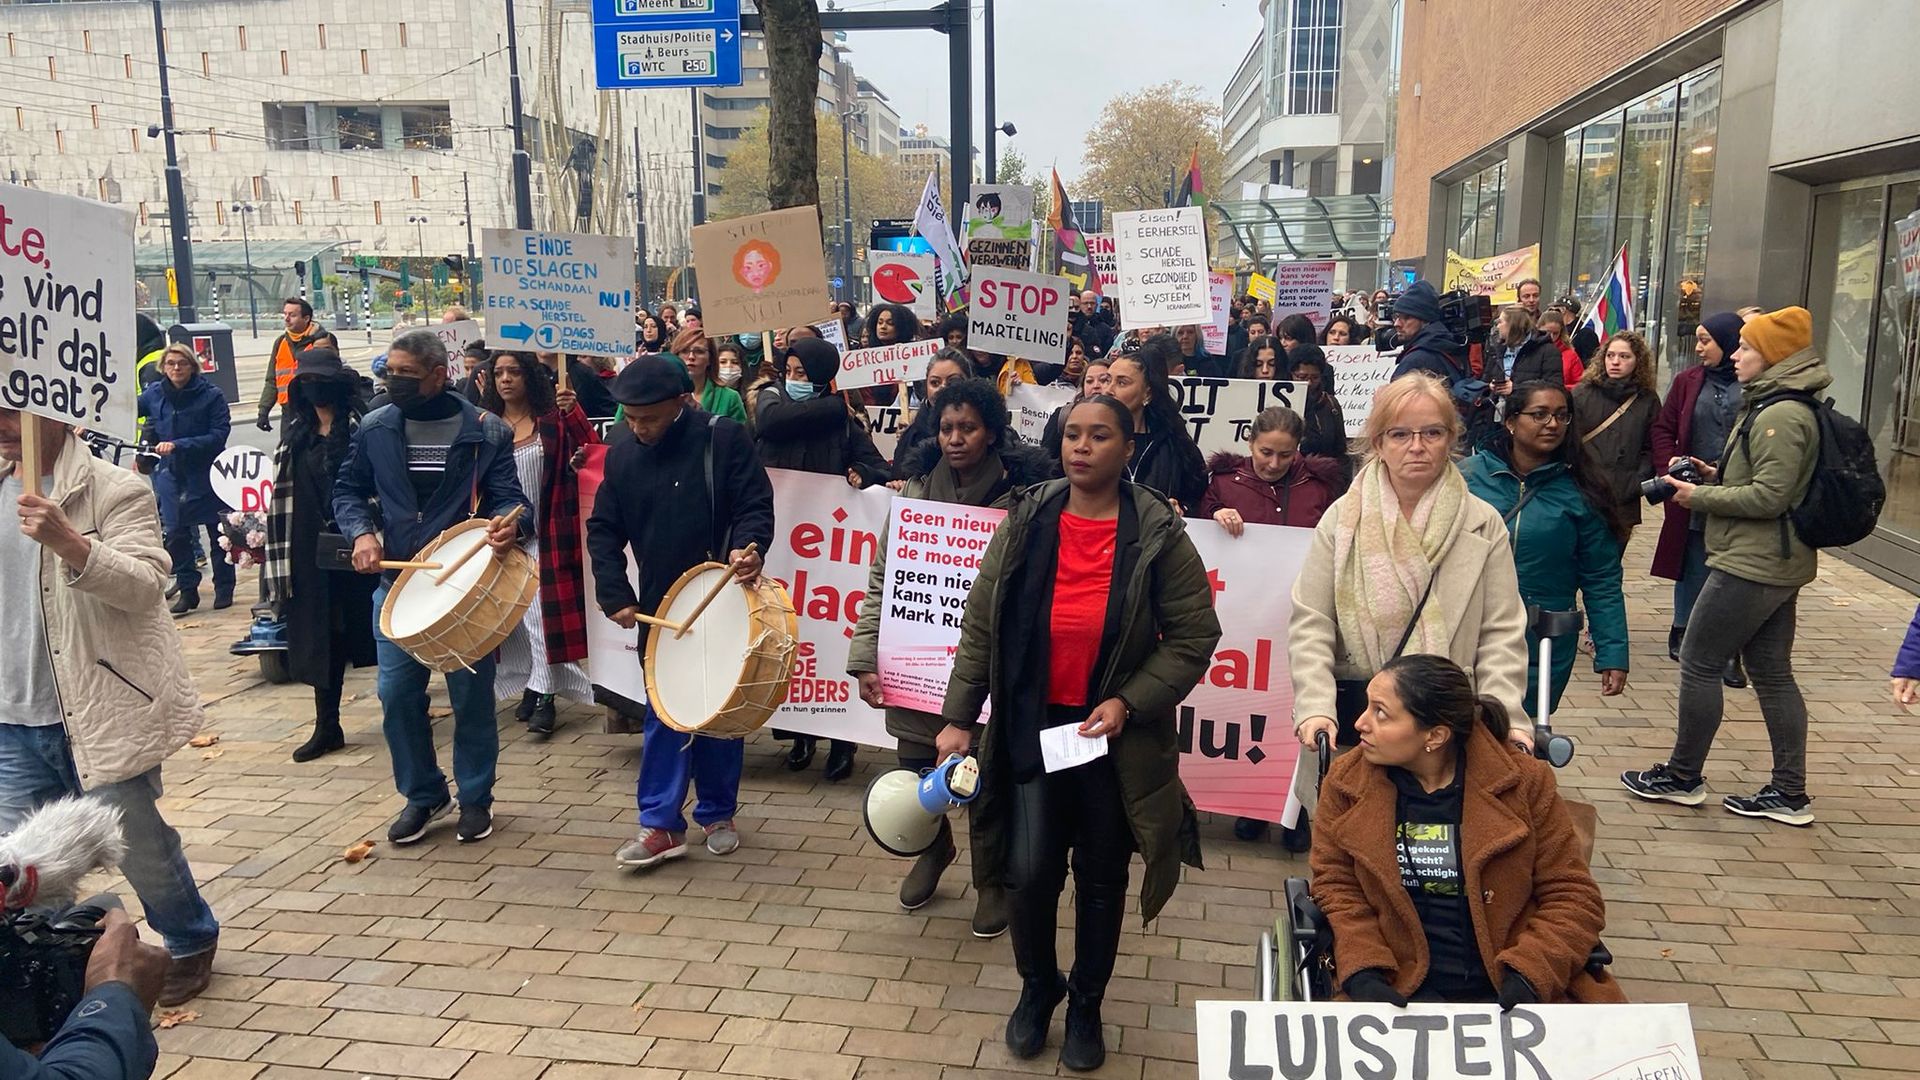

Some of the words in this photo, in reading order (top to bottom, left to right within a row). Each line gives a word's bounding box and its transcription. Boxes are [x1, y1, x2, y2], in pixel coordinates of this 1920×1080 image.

[638, 0, 674, 8] Meent
[620, 33, 712, 46] Stadhuis/Politie
[658, 48, 689, 57] Beurs
[642, 62, 665, 72] WTC
[686, 60, 706, 71] 250
[1139, 210, 1181, 222] Eisen!
[1138, 226, 1198, 238] EERHERSTEL
[968, 240, 1028, 254] GEZINNEN
[1140, 246, 1181, 258] SCHADE
[490, 256, 598, 280] TOESLAGEN
[1162, 258, 1195, 267] HERSTEL
[1142, 272, 1197, 284] GEZONDHEID
[519, 278, 593, 294] SCHANDAAL
[24, 272, 102, 322] vind
[600, 290, 630, 312] NU!
[978, 280, 1058, 316] STOP
[542, 311, 586, 323] HERSTEL
[564, 327, 595, 338] DAGS
[972, 320, 1064, 348] MARTELING!
[562, 340, 633, 354] BEHANDELING
[58, 328, 116, 384] dat
[842, 342, 939, 371] GERECHTIGHEID
[2, 369, 108, 422] gaat?
[1257, 382, 1294, 413] IS
[1021, 417, 1034, 426] ipv
[1021, 434, 1042, 445] Zwa
[214, 452, 266, 480] WIJ
[900, 508, 945, 527] Geen
[898, 526, 938, 544] kans
[946, 535, 988, 550] voor
[897, 545, 918, 560] de
[895, 569, 937, 585] geen
[893, 586, 932, 604] kans
[891, 605, 934, 624] Mark
[811, 706, 846, 714] gezinnen
[1228, 1008, 1552, 1080] LUISTER
